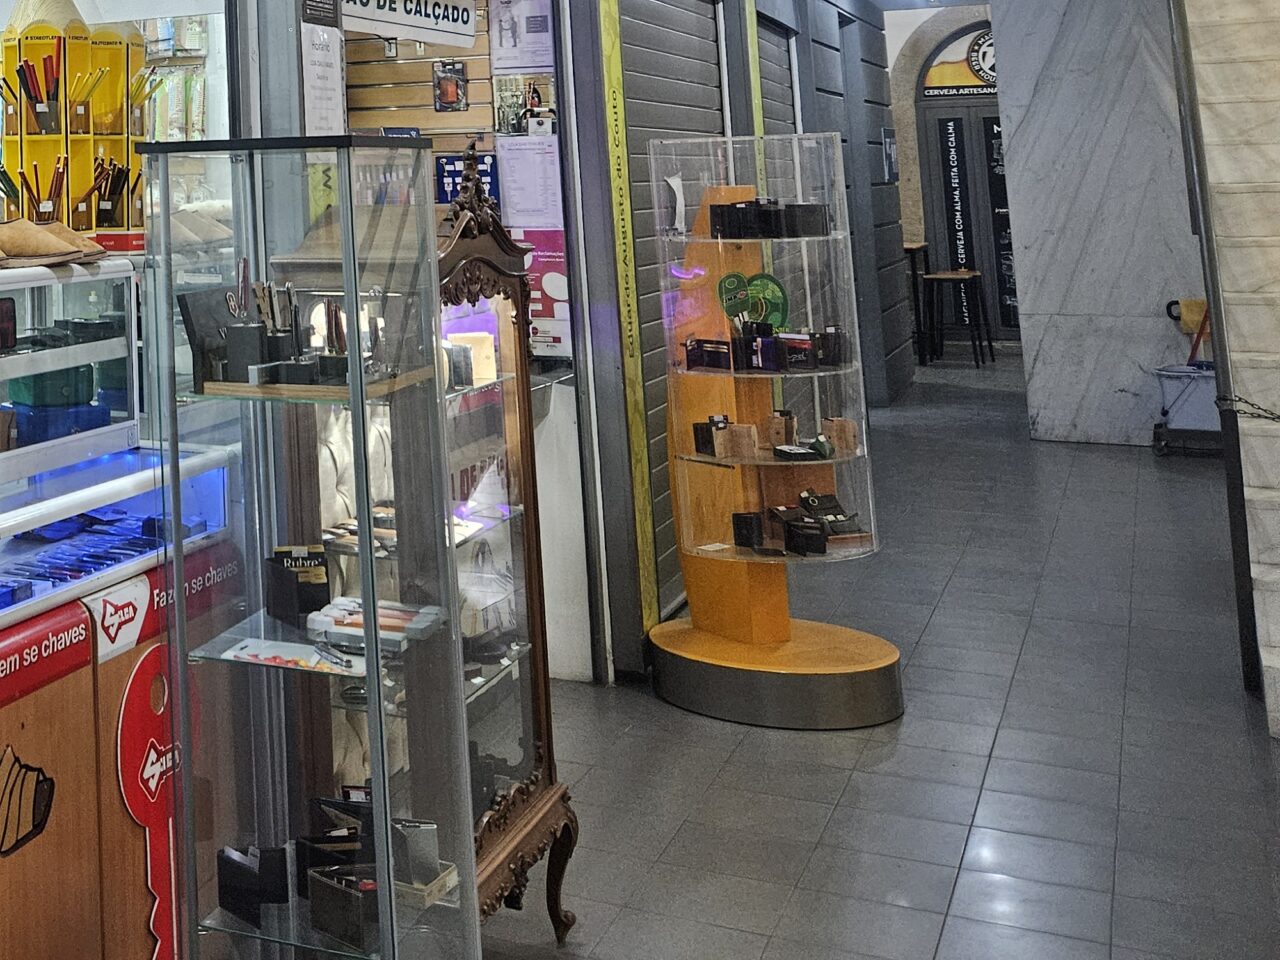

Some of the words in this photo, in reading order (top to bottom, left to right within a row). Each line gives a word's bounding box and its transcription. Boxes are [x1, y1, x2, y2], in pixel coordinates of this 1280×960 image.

[979, 70, 998, 84] HOU
[612, 90, 620, 148] Couto
[946, 121, 956, 147] CALMA
[616, 155, 622, 179] do
[949, 148, 958, 166] COM
[950, 167, 960, 187] FEITA
[955, 211, 963, 230] COM
[956, 231, 966, 264] CERVEJA
[191, 576, 203, 594] se
[205, 560, 239, 587] chaves
[23, 645, 38, 666] se
[41, 623, 86, 657] chaves
